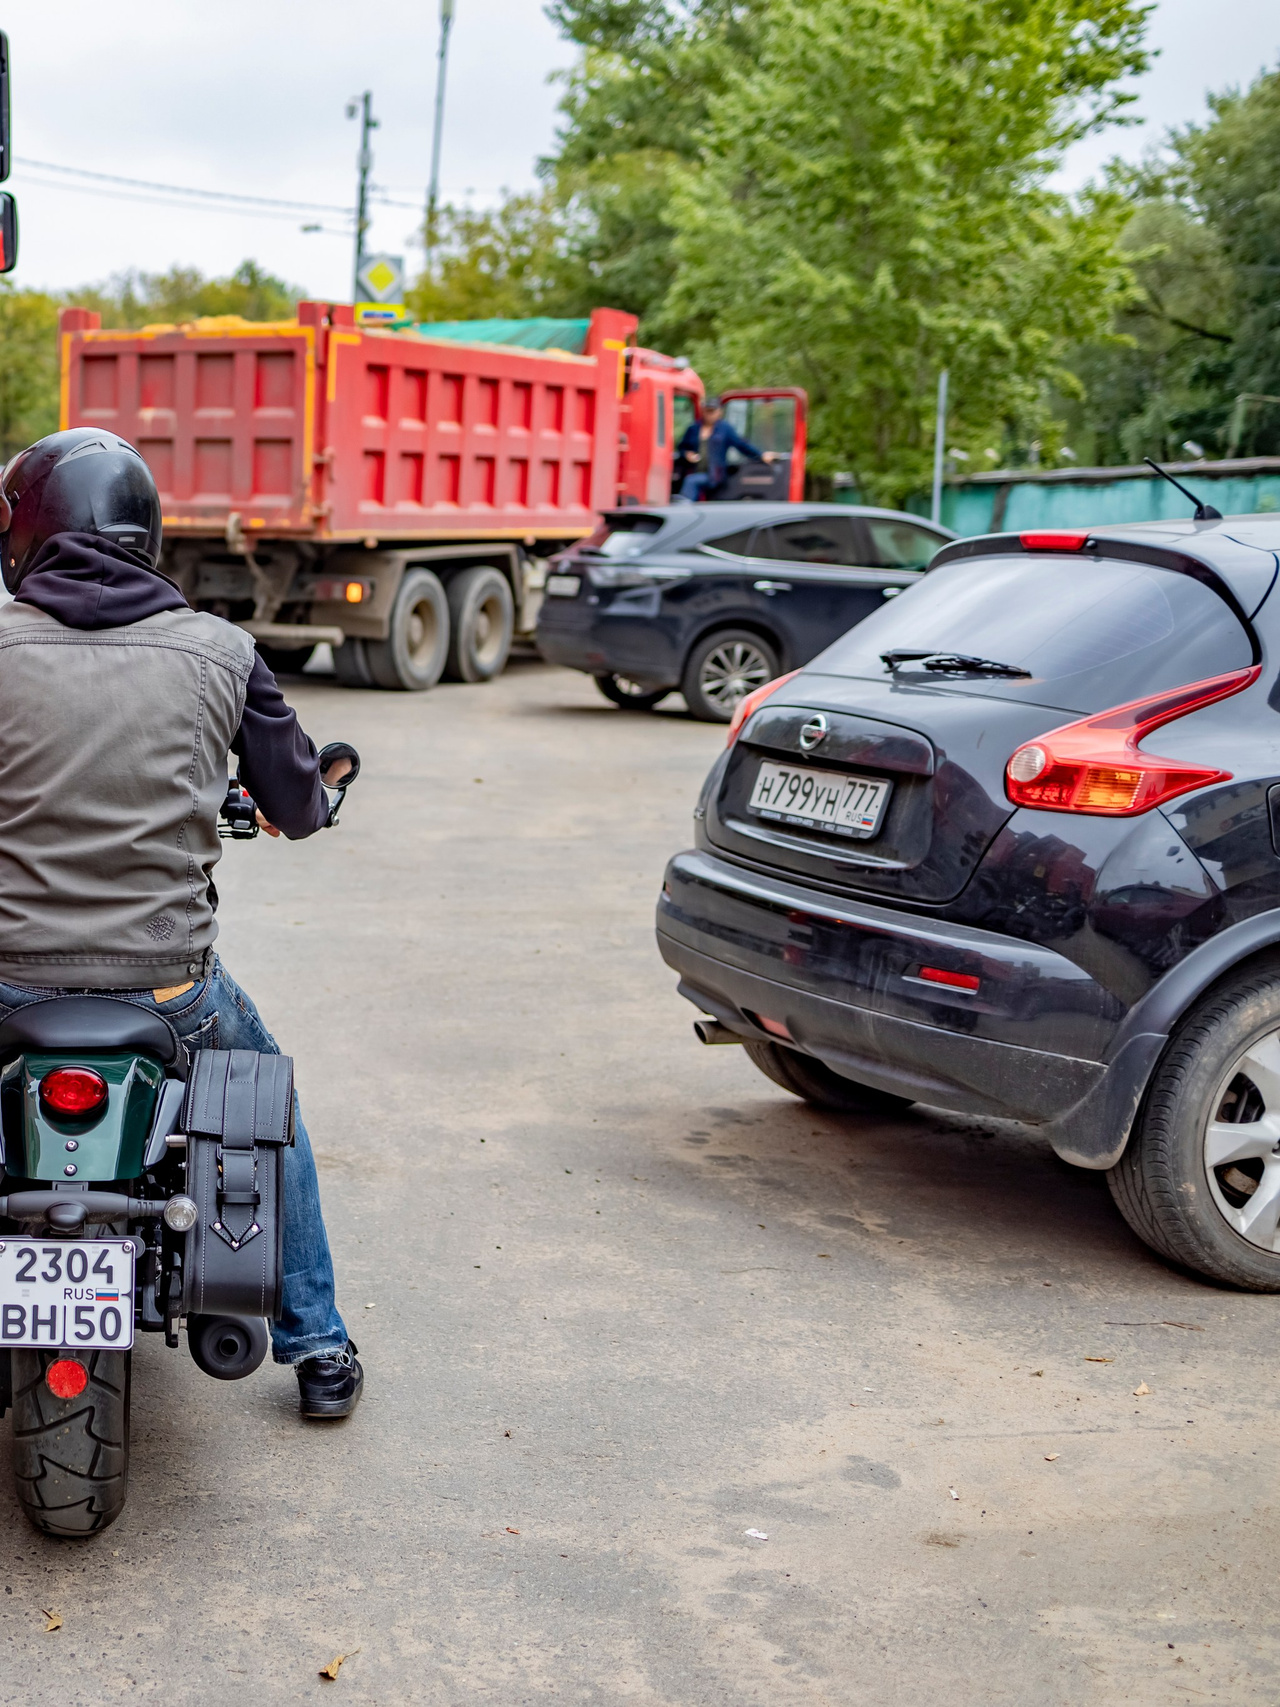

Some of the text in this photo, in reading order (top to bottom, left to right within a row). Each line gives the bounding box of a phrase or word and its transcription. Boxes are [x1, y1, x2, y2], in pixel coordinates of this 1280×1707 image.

[843, 781, 880, 812] 777
[845, 810, 863, 823] RUS
[15, 1247, 114, 1284] 2304
[63, 1287, 95, 1300] RUS
[74, 1306, 122, 1341] 50
